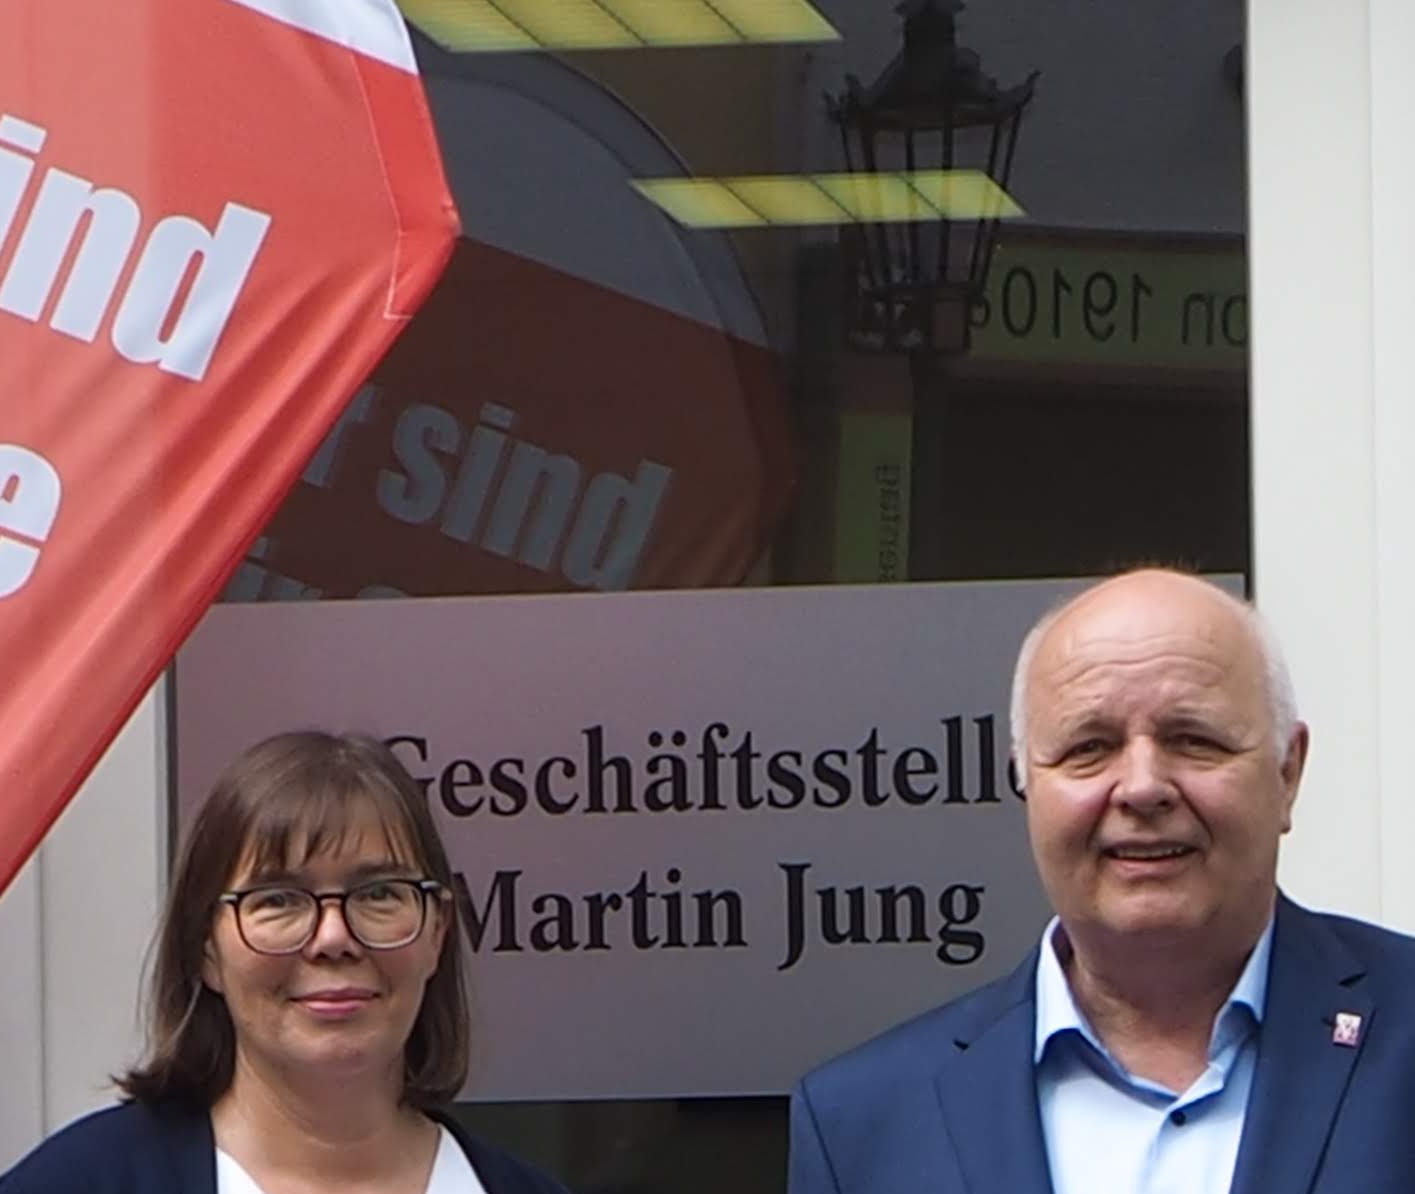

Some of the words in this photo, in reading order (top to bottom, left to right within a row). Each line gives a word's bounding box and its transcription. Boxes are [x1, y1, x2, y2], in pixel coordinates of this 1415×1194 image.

[376, 401, 674, 593] sind
[451, 867, 747, 954] Martin
[777, 862, 987, 970] Jung
